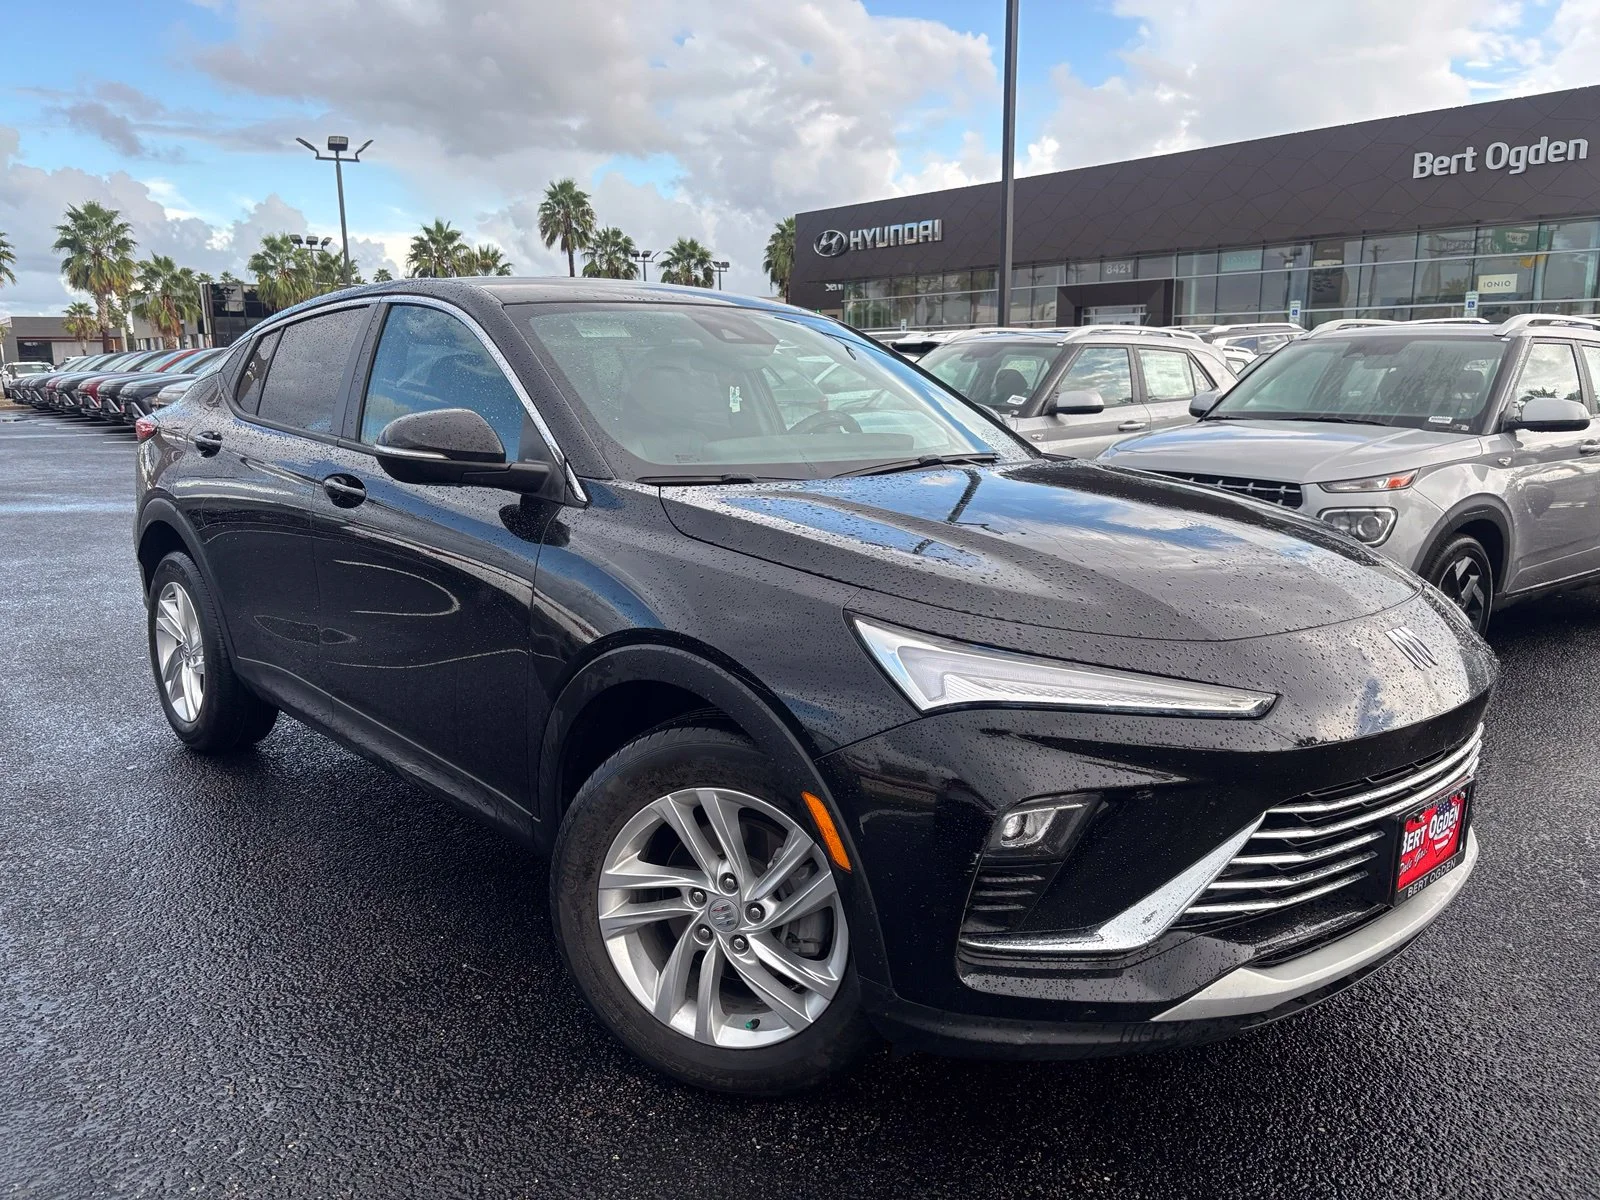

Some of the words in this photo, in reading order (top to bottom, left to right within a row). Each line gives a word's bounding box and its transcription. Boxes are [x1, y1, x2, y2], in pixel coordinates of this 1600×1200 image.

[1412, 146, 1478, 179] Bert
[1485, 136, 1589, 175] Ogden
[849, 219, 943, 251] HYUNDAI
[1106, 264, 1131, 274] 8421
[1483, 280, 1512, 288] IONIQ
[1428, 804, 1460, 839] OGDEN
[1407, 876, 1429, 898] BERT
[1429, 858, 1456, 883] OGDEN
